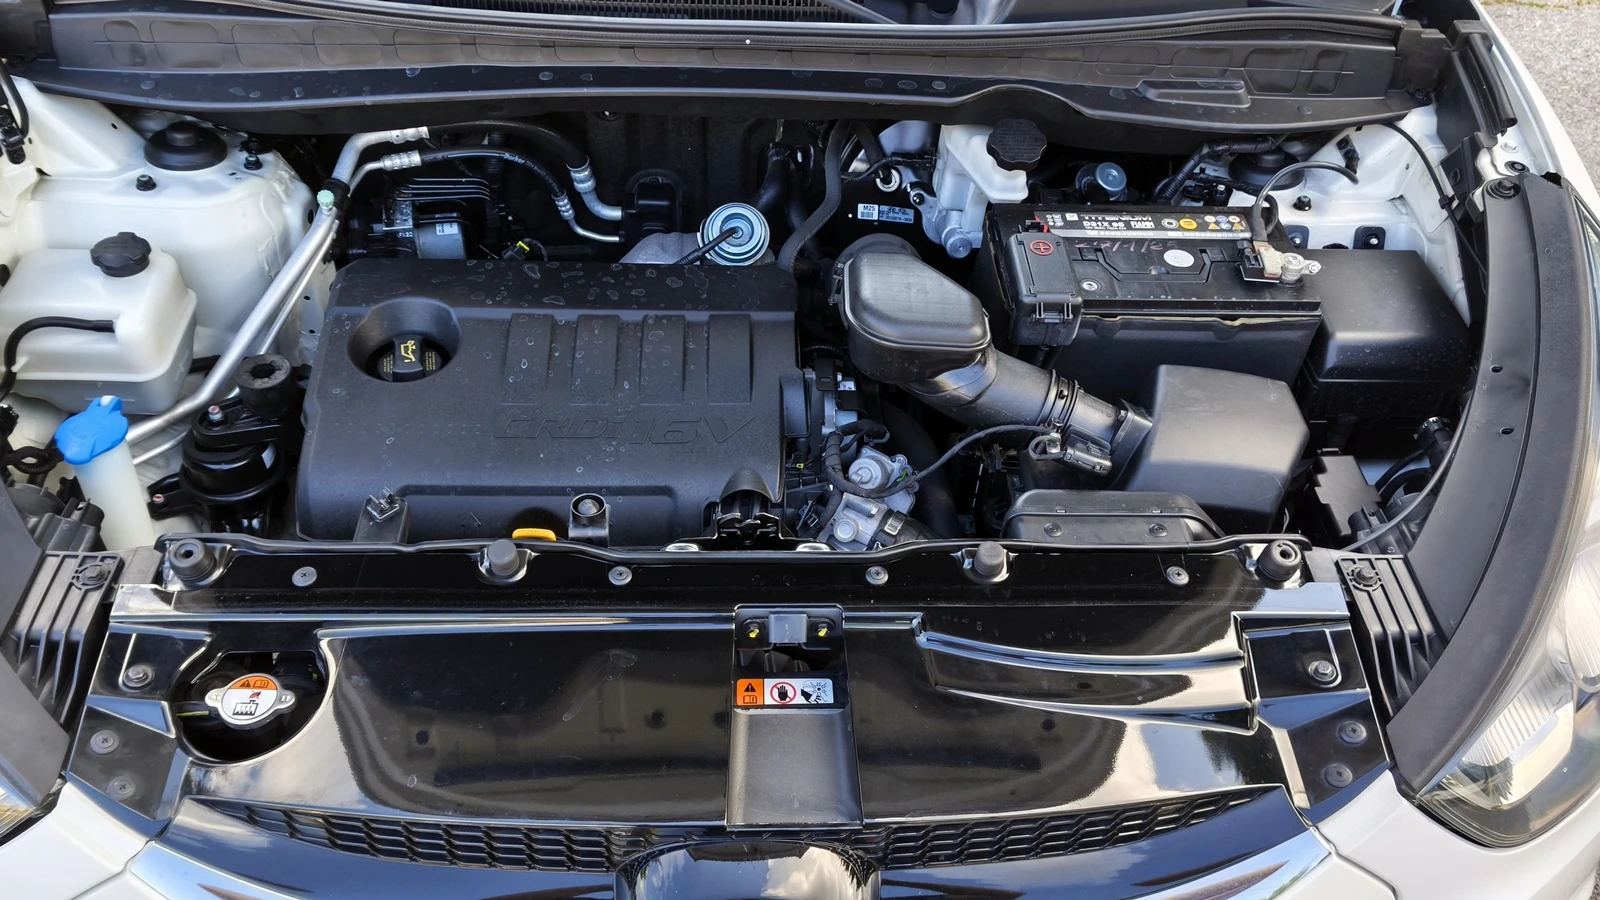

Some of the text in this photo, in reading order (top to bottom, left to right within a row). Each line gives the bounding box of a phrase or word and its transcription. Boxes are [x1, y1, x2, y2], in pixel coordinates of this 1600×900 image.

[504, 153, 525, 164] Parker
[1130, 221, 1155, 229] FIAMM
[629, 416, 756, 444] 16V
